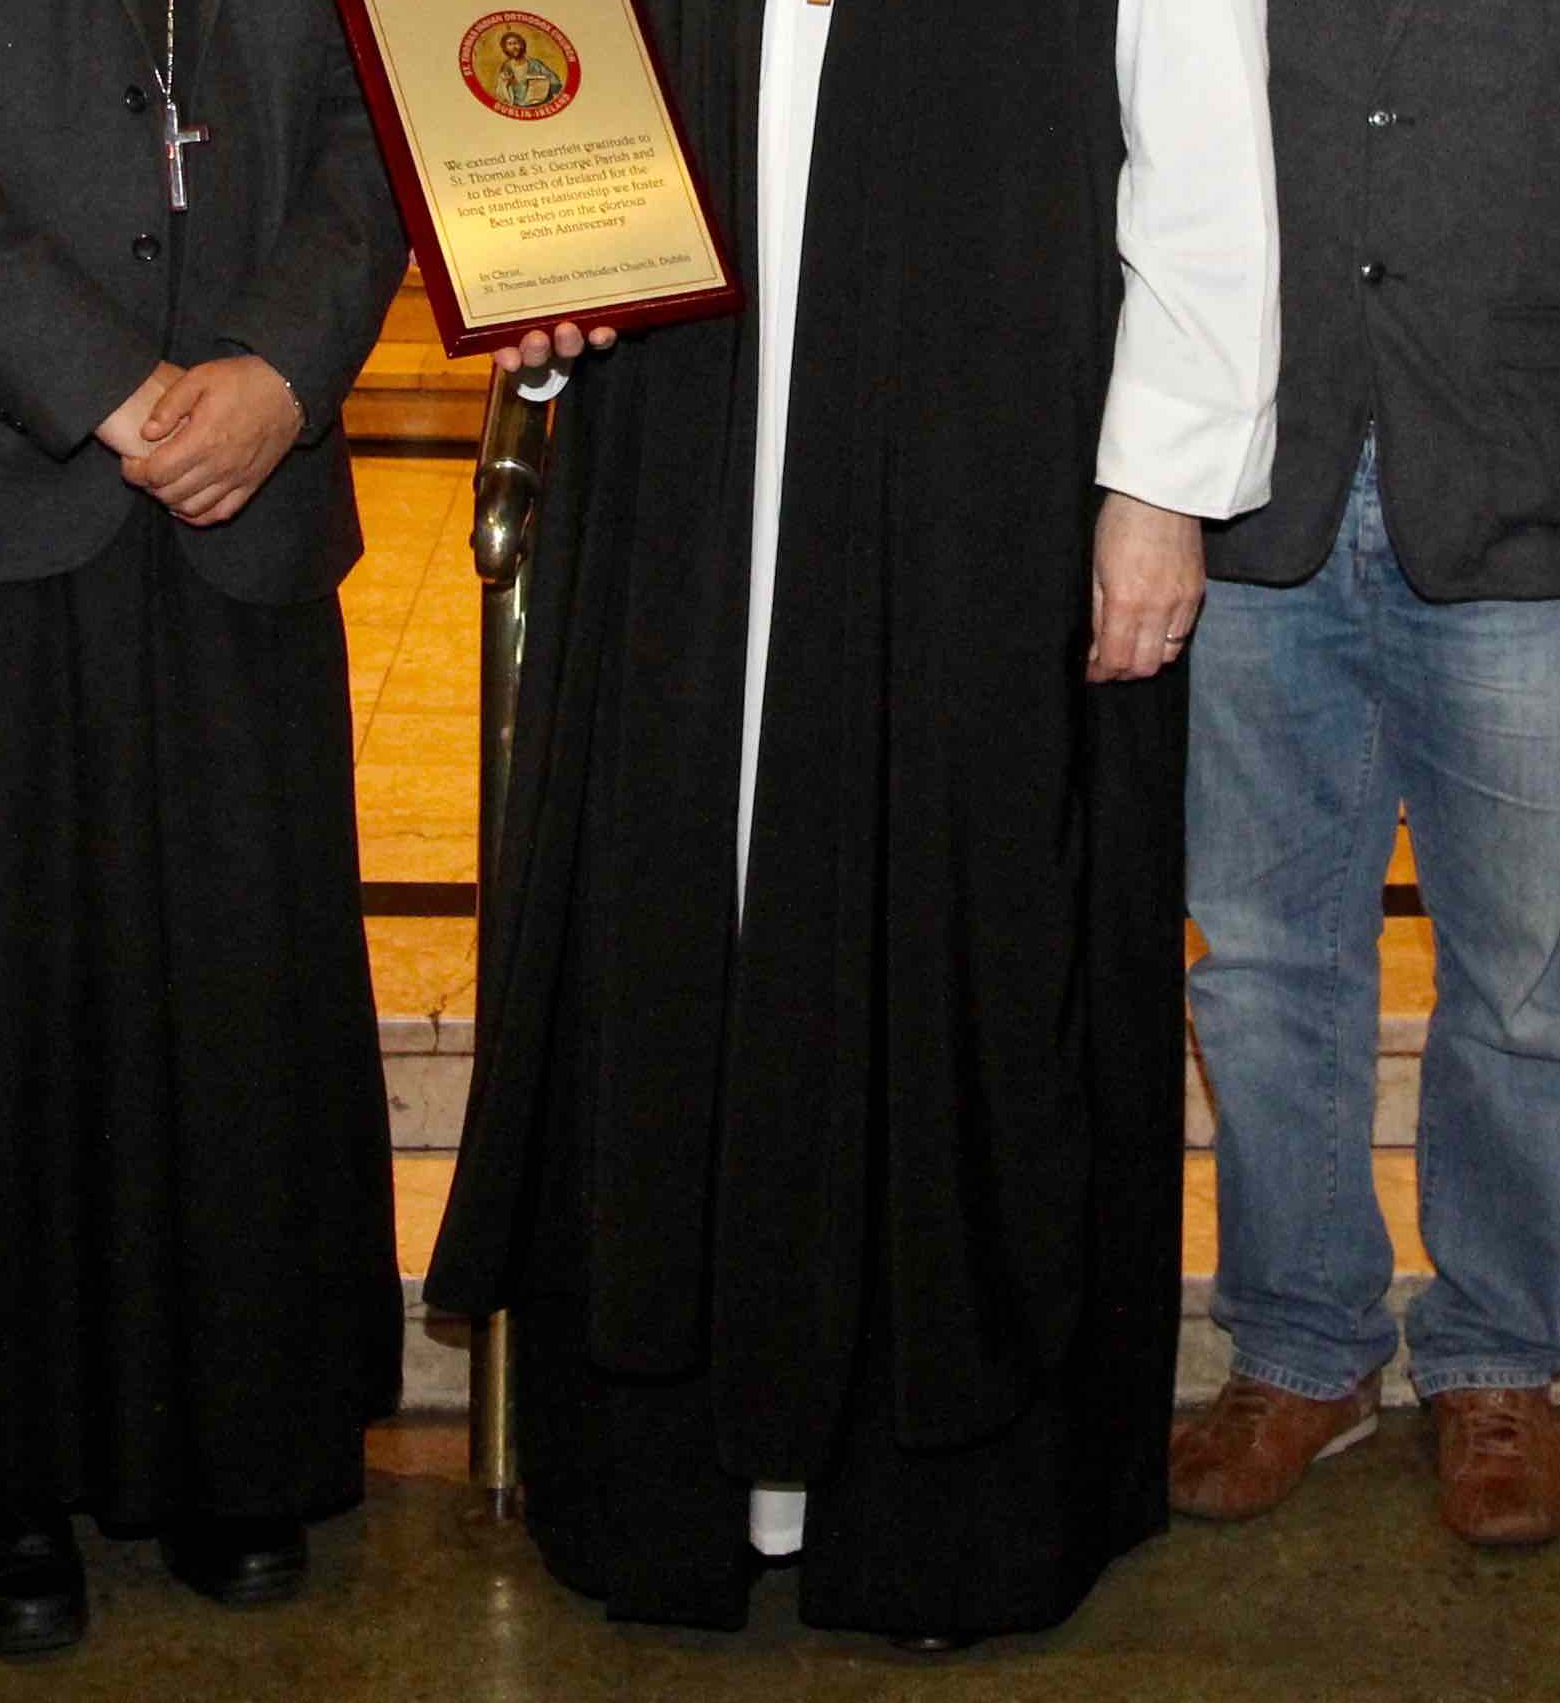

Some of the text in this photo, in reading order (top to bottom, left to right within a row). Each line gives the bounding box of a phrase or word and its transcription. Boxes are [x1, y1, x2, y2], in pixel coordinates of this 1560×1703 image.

[461, 30, 479, 63] THOMAS
[475, 14, 503, 32] INDIAN
[503, 12, 552, 32] ORTHODOX
[550, 29, 577, 63] CHURCH
[444, 135, 652, 171] We extend our heartfelt gratitude to
[468, 170, 516, 185] Thomas
[519, 166, 528, 176] &
[548, 159, 592, 172] George
[594, 152, 630, 166] Parish
[632, 147, 655, 160] and
[457, 206, 486, 217] long
[488, 197, 539, 213] standing
[541, 185, 610, 204] relationship
[613, 183, 630, 193] we
[467, 164, 648, 200] to the Church of Ireland for the
[489, 197, 646, 228] Best wishes on the glorious
[555, 215, 626, 235] Anniversary
[479, 272, 490, 281] In
[497, 280, 537, 291] Thomas
[539, 273, 571, 285] Indian
[571, 266, 619, 280] Orthodox
[659, 253, 692, 265] Dublin
